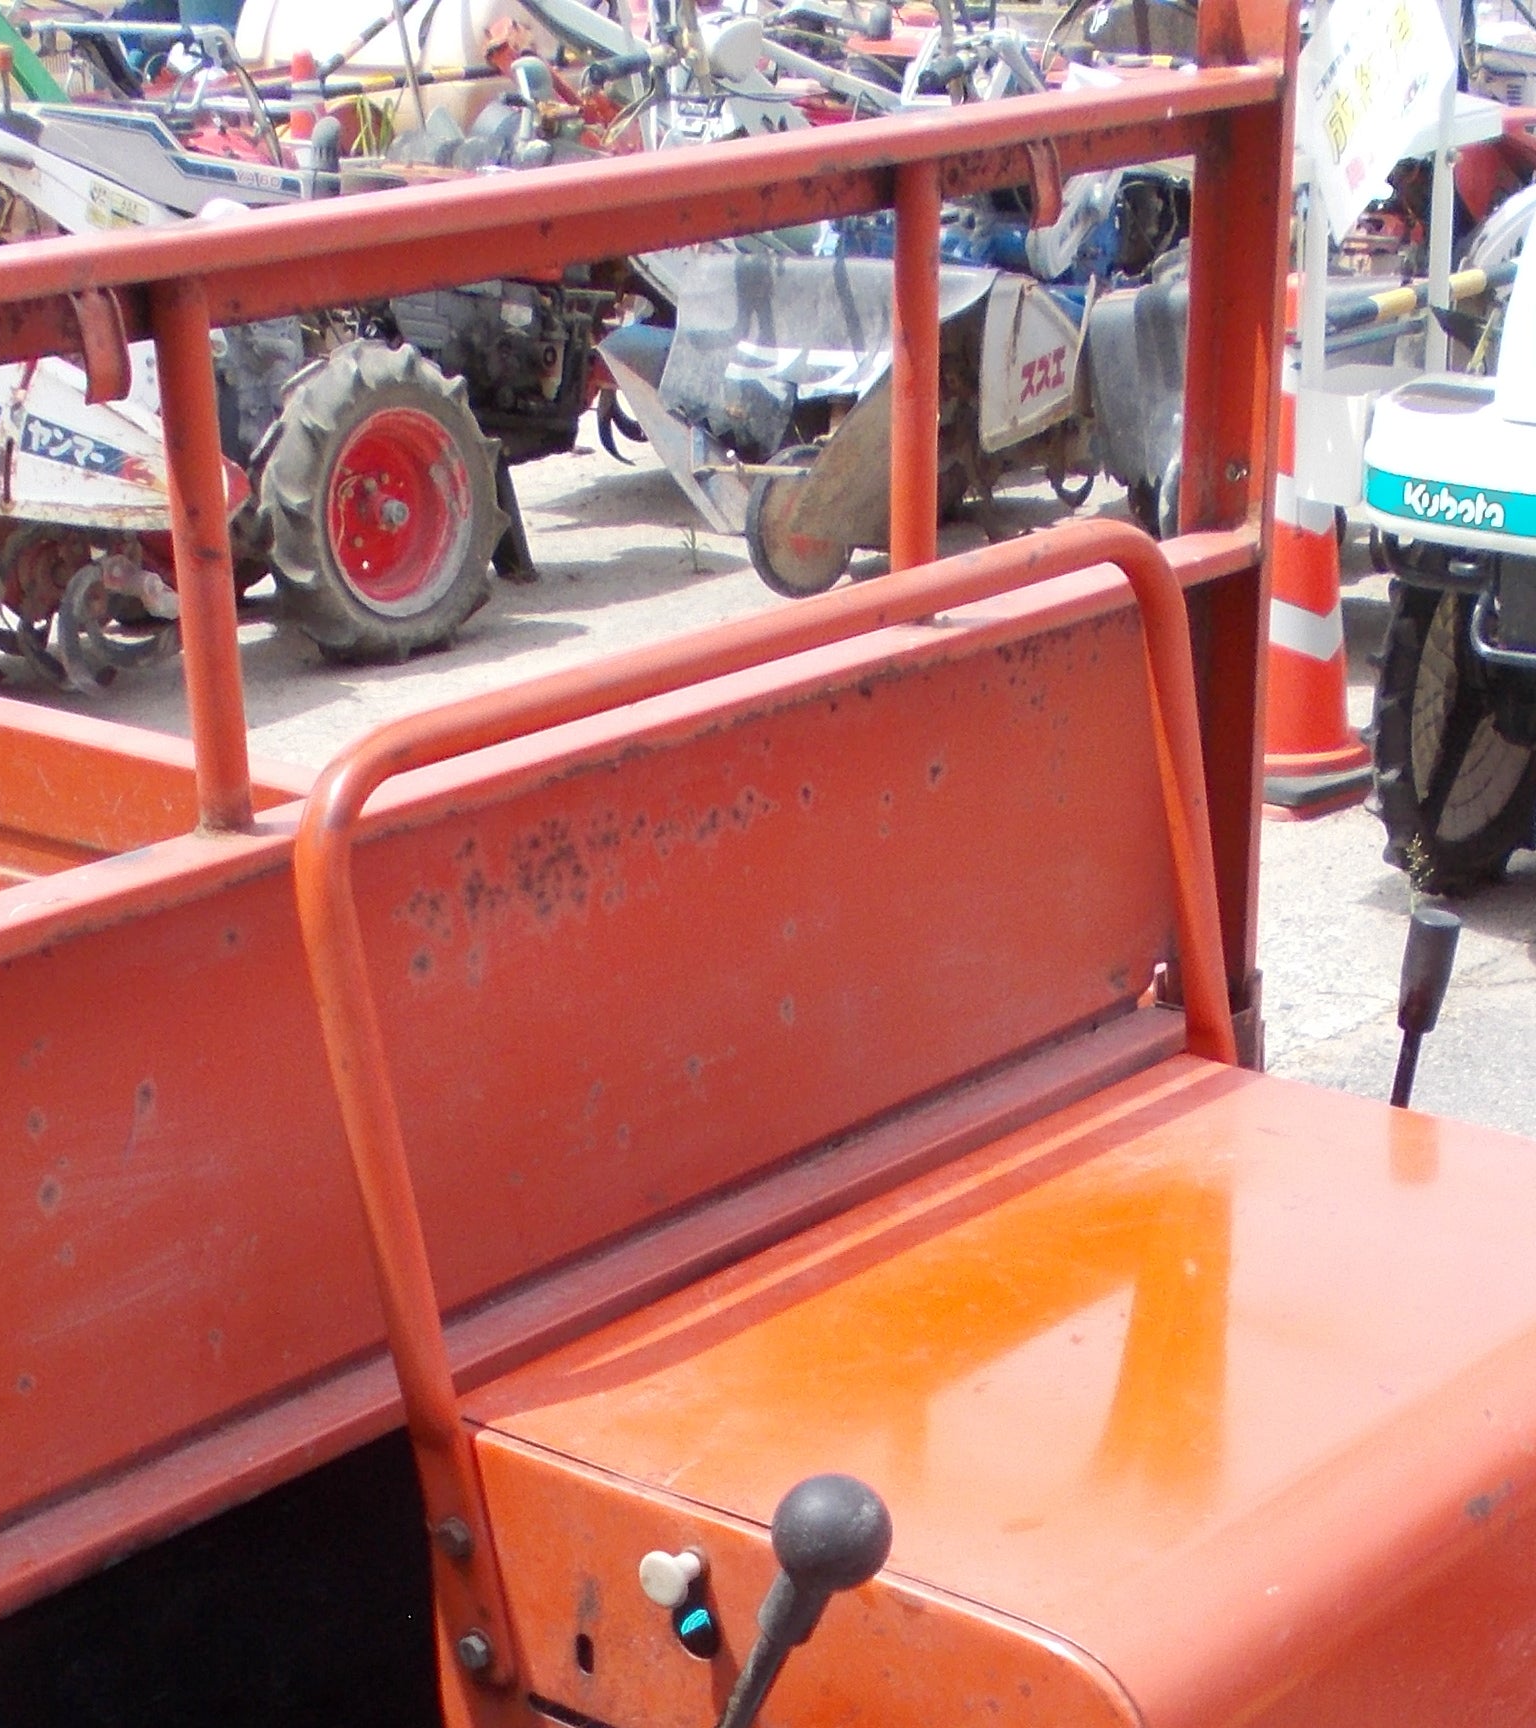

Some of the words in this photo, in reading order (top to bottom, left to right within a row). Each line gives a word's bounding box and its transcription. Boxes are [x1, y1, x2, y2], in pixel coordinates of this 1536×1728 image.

[28, 419, 105, 466] ヤンマー
[1404, 481, 1505, 528] Kubota
